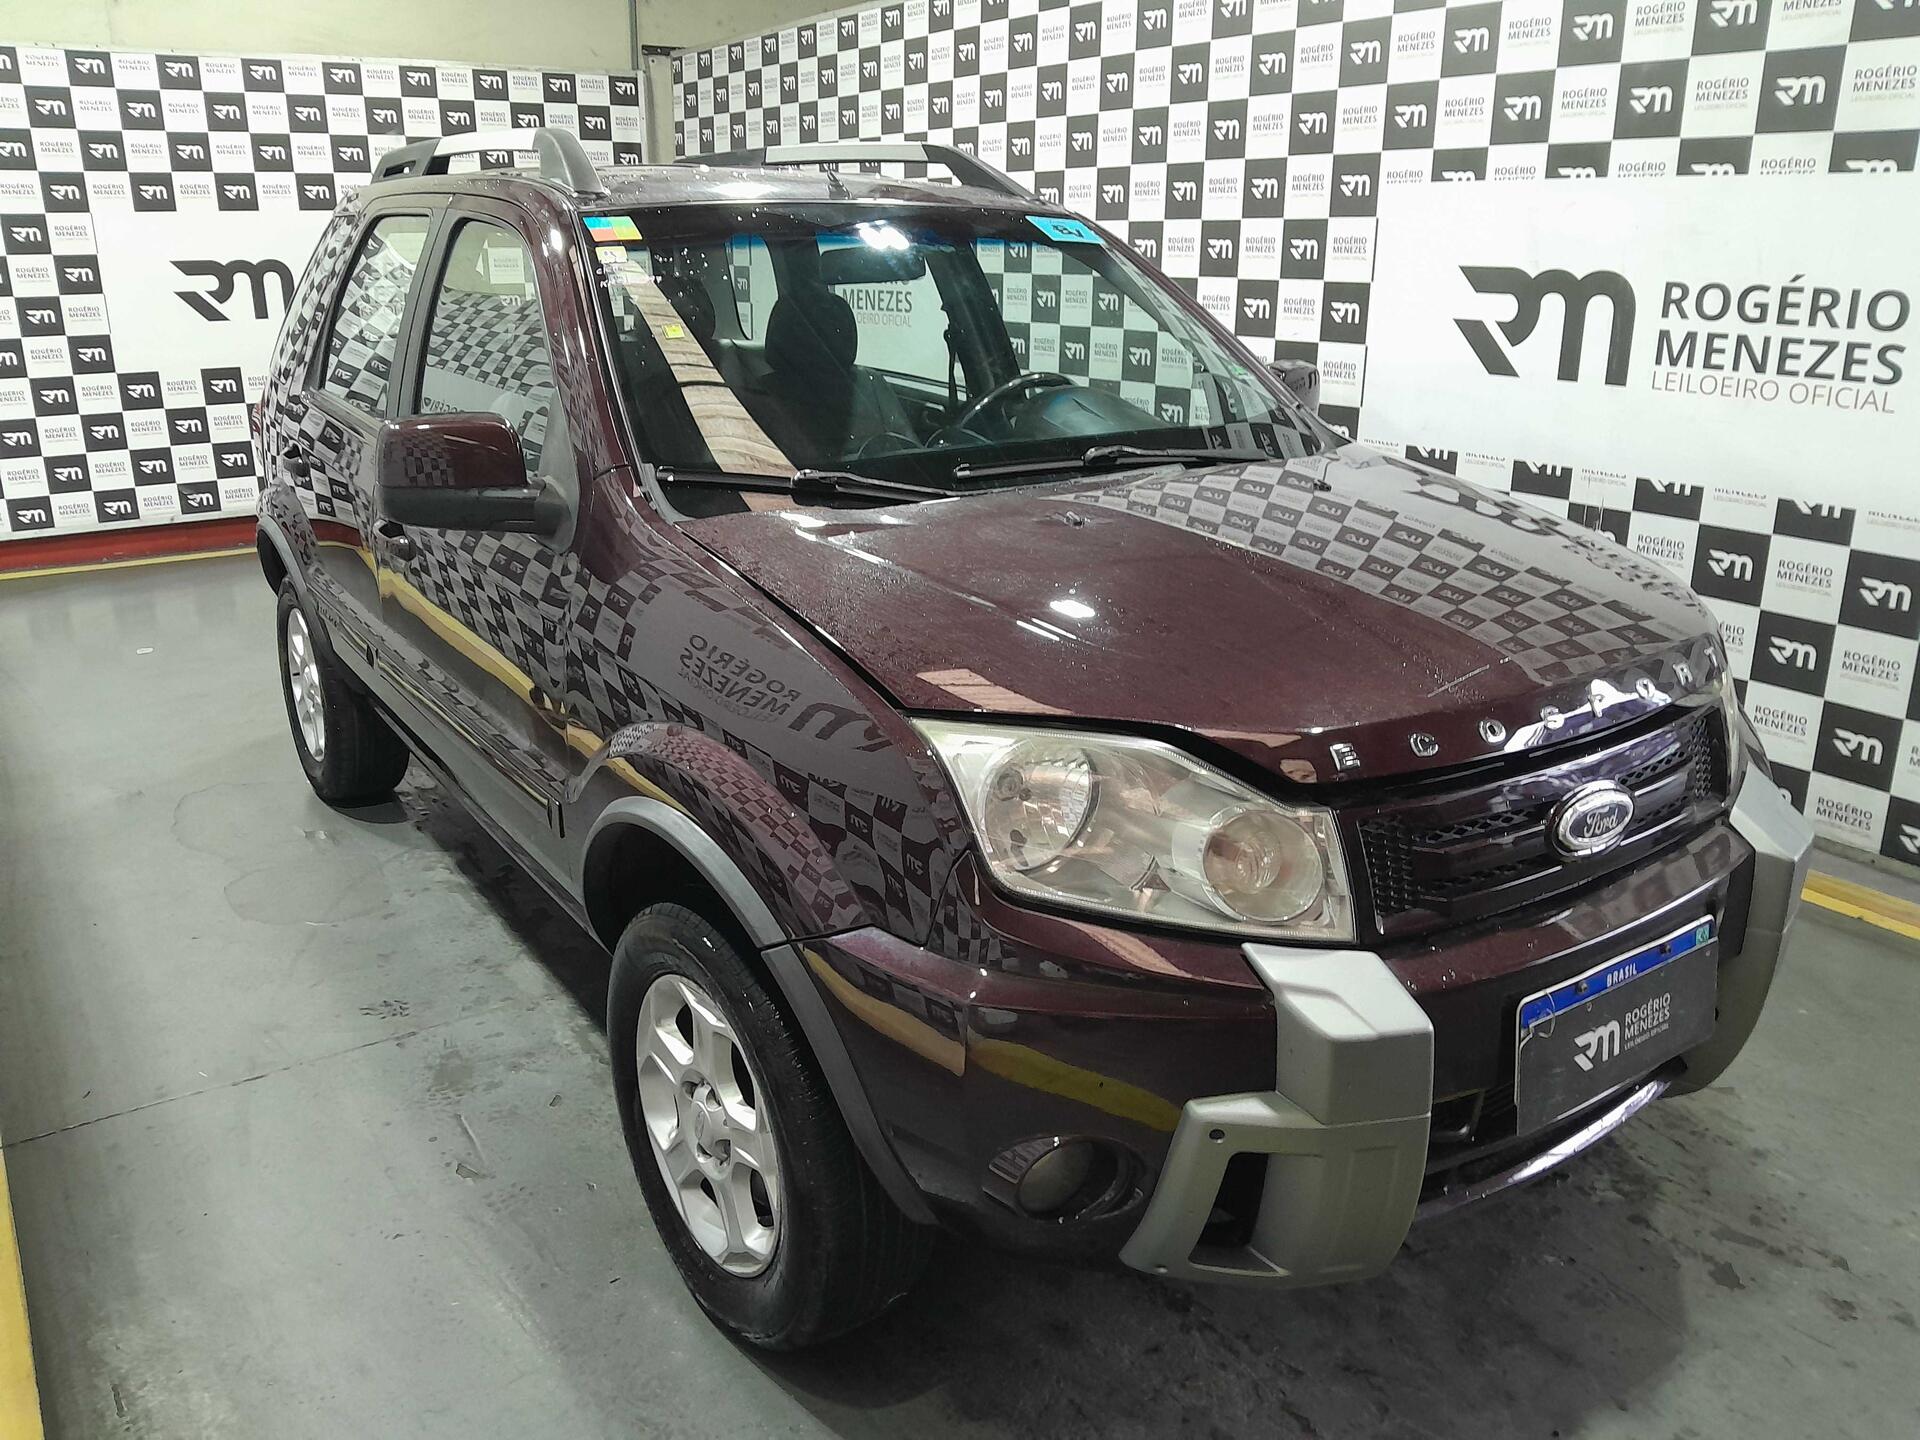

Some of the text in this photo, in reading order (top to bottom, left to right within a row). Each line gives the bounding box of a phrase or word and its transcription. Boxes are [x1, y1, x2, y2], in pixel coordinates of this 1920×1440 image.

[1636, 1, 1687, 15] ROGÉRIO
[1509, 16, 1552, 30] ROGÉRIO
[1635, 12, 1685, 27] MENEZES
[1508, 27, 1551, 41] MENEZES
[1397, 40, 1435, 53] MENEZES
[1300, 53, 1333, 64] MENEZES
[1215, 63, 1244, 74] MENEZES
[1854, 65, 1918, 79] ROGÉRIO
[1139, 73, 1165, 83] MENEZES
[1696, 77, 1750, 90] ROGÉRIO
[1853, 78, 1915, 93] MENEZES
[1562, 87, 1608, 99] ROGÉRIO
[1695, 89, 1748, 102] MENEZES
[1445, 97, 1485, 107] ROGÉRIO
[1561, 98, 1607, 110] MENEZES
[1444, 106, 1484, 118] MENEZES
[1342, 115, 1377, 125] MENEZES
[1173, 128, 1200, 137] MENEZES
[1253, 122, 1283, 132] MENEZES
[1618, 161, 1667, 172] ROGÉRIO
[1760, 157, 1817, 168] ROGÉRIO
[1387, 169, 1423, 178] ROGÉRIO
[1495, 165, 1537, 175] ROGÉRIO
[1209, 186, 1237, 194] MENEZES
[1292, 182, 1324, 191] MENEZES
[1245, 245, 1275, 253] MENEZES
[1333, 245, 1366, 254] MENEZES
[843, 288, 912, 313] MENEZES
[1065, 296, 1087, 304] MENEZES
[1661, 274, 1910, 332] ROGÉRIO
[1283, 306, 1314, 315] MENEZES
[1094, 349, 1118, 358] MENEZES
[1161, 355, 1187, 365] MENEZES
[1654, 329, 1906, 386] MENEZES
[1323, 369, 1356, 380] MENEZES
[1651, 370, 1895, 414] LEILOEIRO OFICIAL
[95, 466, 126, 474] MENEZES
[225, 492, 254, 500] MENEZES
[1637, 534, 1685, 550] ROGÉRIO
[1636, 544, 1684, 561] MENEZES
[1778, 559, 1834, 577] ROGÉRIO
[1776, 569, 1832, 588] MENEZES
[1843, 650, 1902, 670] ROGÉRIO
[1841, 660, 1900, 682] MENEZES
[1755, 705, 1808, 725] ROGÉRIO
[1753, 714, 1806, 736] MENEZES
[1817, 796, 1874, 820] ROGÉRIO
[1583, 807, 1619, 837] Ford
[1815, 806, 1872, 831] MENEZES
[1606, 963, 1637, 987] BRASIL
[1625, 992, 1670, 1026] ROGÉRIO
[1624, 1006, 1670, 1040] MENEZES
